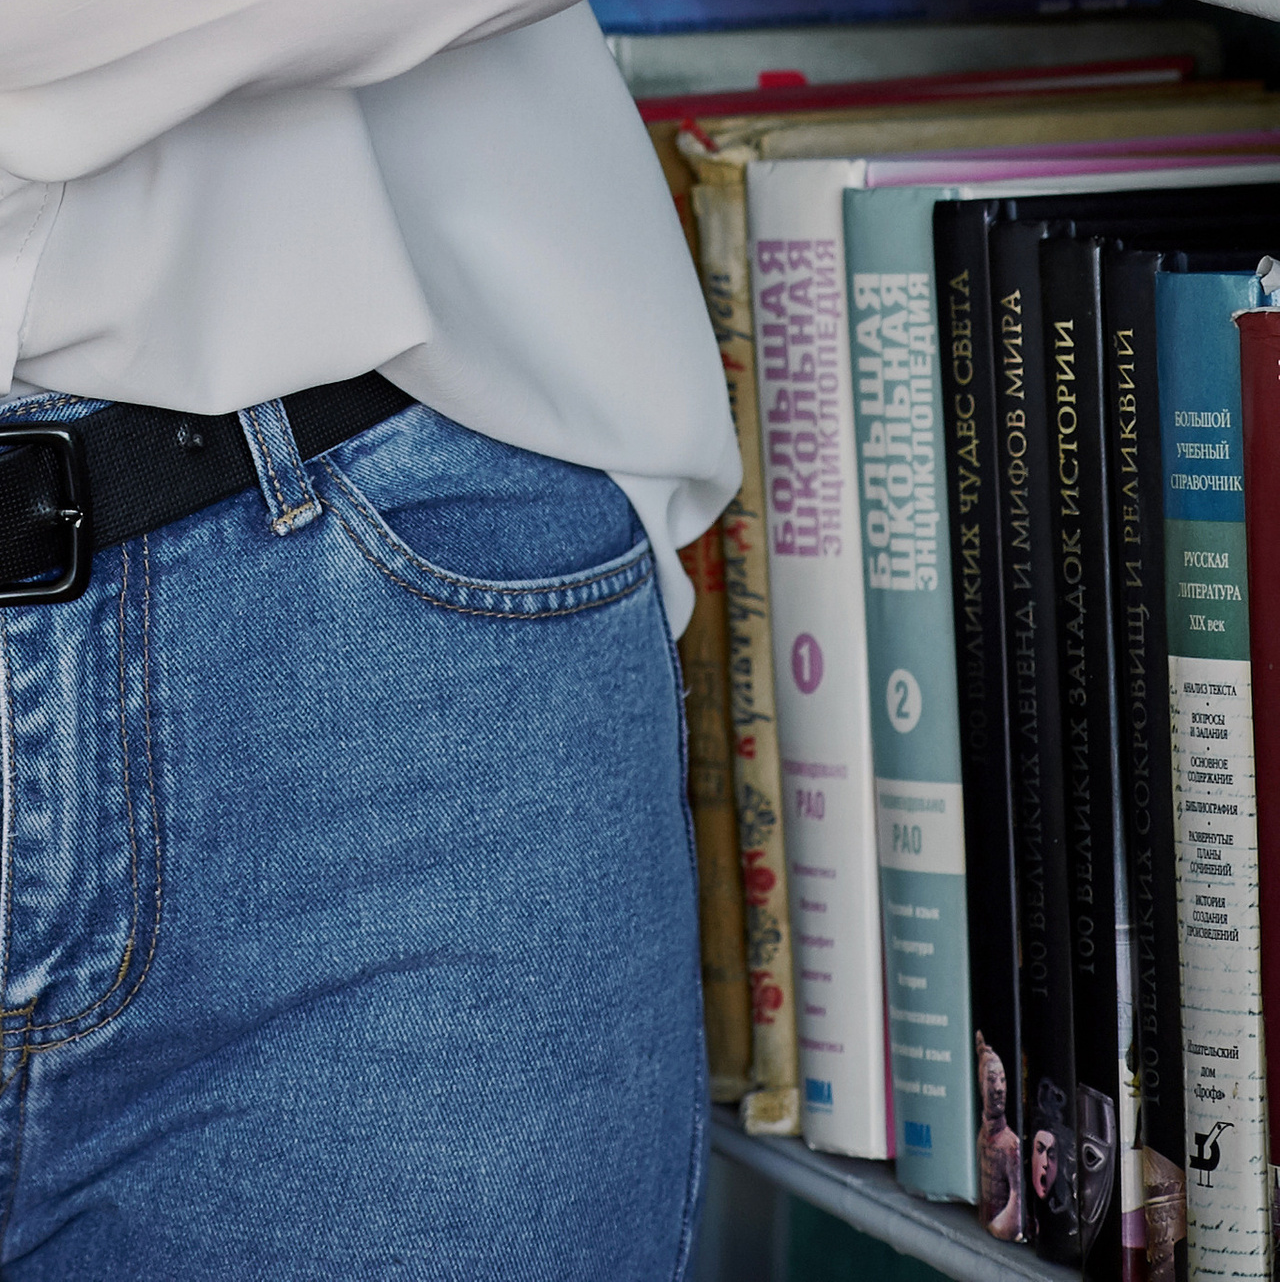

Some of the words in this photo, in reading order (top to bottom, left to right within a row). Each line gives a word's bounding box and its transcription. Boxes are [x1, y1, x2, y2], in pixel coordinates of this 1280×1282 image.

[951, 268, 976, 387] СВЕТА
[1002, 288, 1026, 400] МИРА
[757, 238, 796, 557] БОЛЬШАЯ
[787, 238, 820, 558] ШКОЛЬНАЯ
[814, 238, 844, 558] ЭНЦИКЛОПЕДИЯ
[852, 272, 892, 590] БОЛЬШАЯ
[881, 272, 916, 591] ШКОЛЬНАЯ
[907, 272, 940, 592] ЭНЦИКЛОПЕДИЯ
[1053, 318, 1081, 518] ИСТОРИИ
[1174, 408, 1231, 428] БОЛЬШОЙ
[954, 392, 980, 515] ЧУДЕС
[1116, 327, 1142, 546] РЕЛИКВИЙ
[1176, 440, 1230, 460] УЧЕБНЫЙ
[1006, 407, 1031, 553] МИФОВ
[1170, 473, 1243, 492] СПРАВОЧНИК
[1009, 560, 1034, 592] И
[1120, 559, 1144, 586] И
[1183, 550, 1229, 569] РУССКАЯ
[1178, 582, 1242, 601] ЛИТЕРАТУРА
[1061, 528, 1088, 707] ЗАГАДОК
[1207, 619, 1226, 632] век
[798, 641, 811, 683] 1
[1012, 600, 1039, 746] ЛЕГЕНД
[894, 680, 911, 720] 2
[1183, 682, 1208, 696] АНАЛИЗ
[1208, 683, 1237, 697] ТЕКСТА
[1125, 602, 1152, 836] СОКРОВИЩ
[1191, 712, 1225, 726] ВОПРОСЫ
[1196, 728, 1228, 740] ЗАДАНИЯ
[1187, 771, 1234, 785] СОДЕРЖАНИЕ
[1190, 756, 1229, 770] ОСНОВНОЕ
[1069, 715, 1093, 905] ВЕЛИКИХ
[1185, 799, 1238, 817] БИБЛИОГРАФИЯ
[892, 823, 923, 855] РАО
[1019, 751, 1047, 933] ВЕЛИКИХ
[1188, 829, 1234, 846] РАЗВЕРНУТЫЕ
[1196, 847, 1222, 861] ПЛАНЫ
[1189, 861, 1232, 877] СОЧИНЕНИЙ
[1192, 909, 1228, 925] СОЗДАНИЯ
[1195, 894, 1226, 909] ИСТОРИЯ
[1076, 911, 1097, 977] 100
[1135, 849, 1159, 1033] ВЕЛИКИХ
[1186, 925, 1239, 942] ПРОИЗВЕДЕНИЙ
[1026, 939, 1049, 999] 100
[1187, 1038, 1239, 1060] Издательский
[1142, 1045, 1162, 1107] 100
[1200, 1067, 1216, 1080] дом
